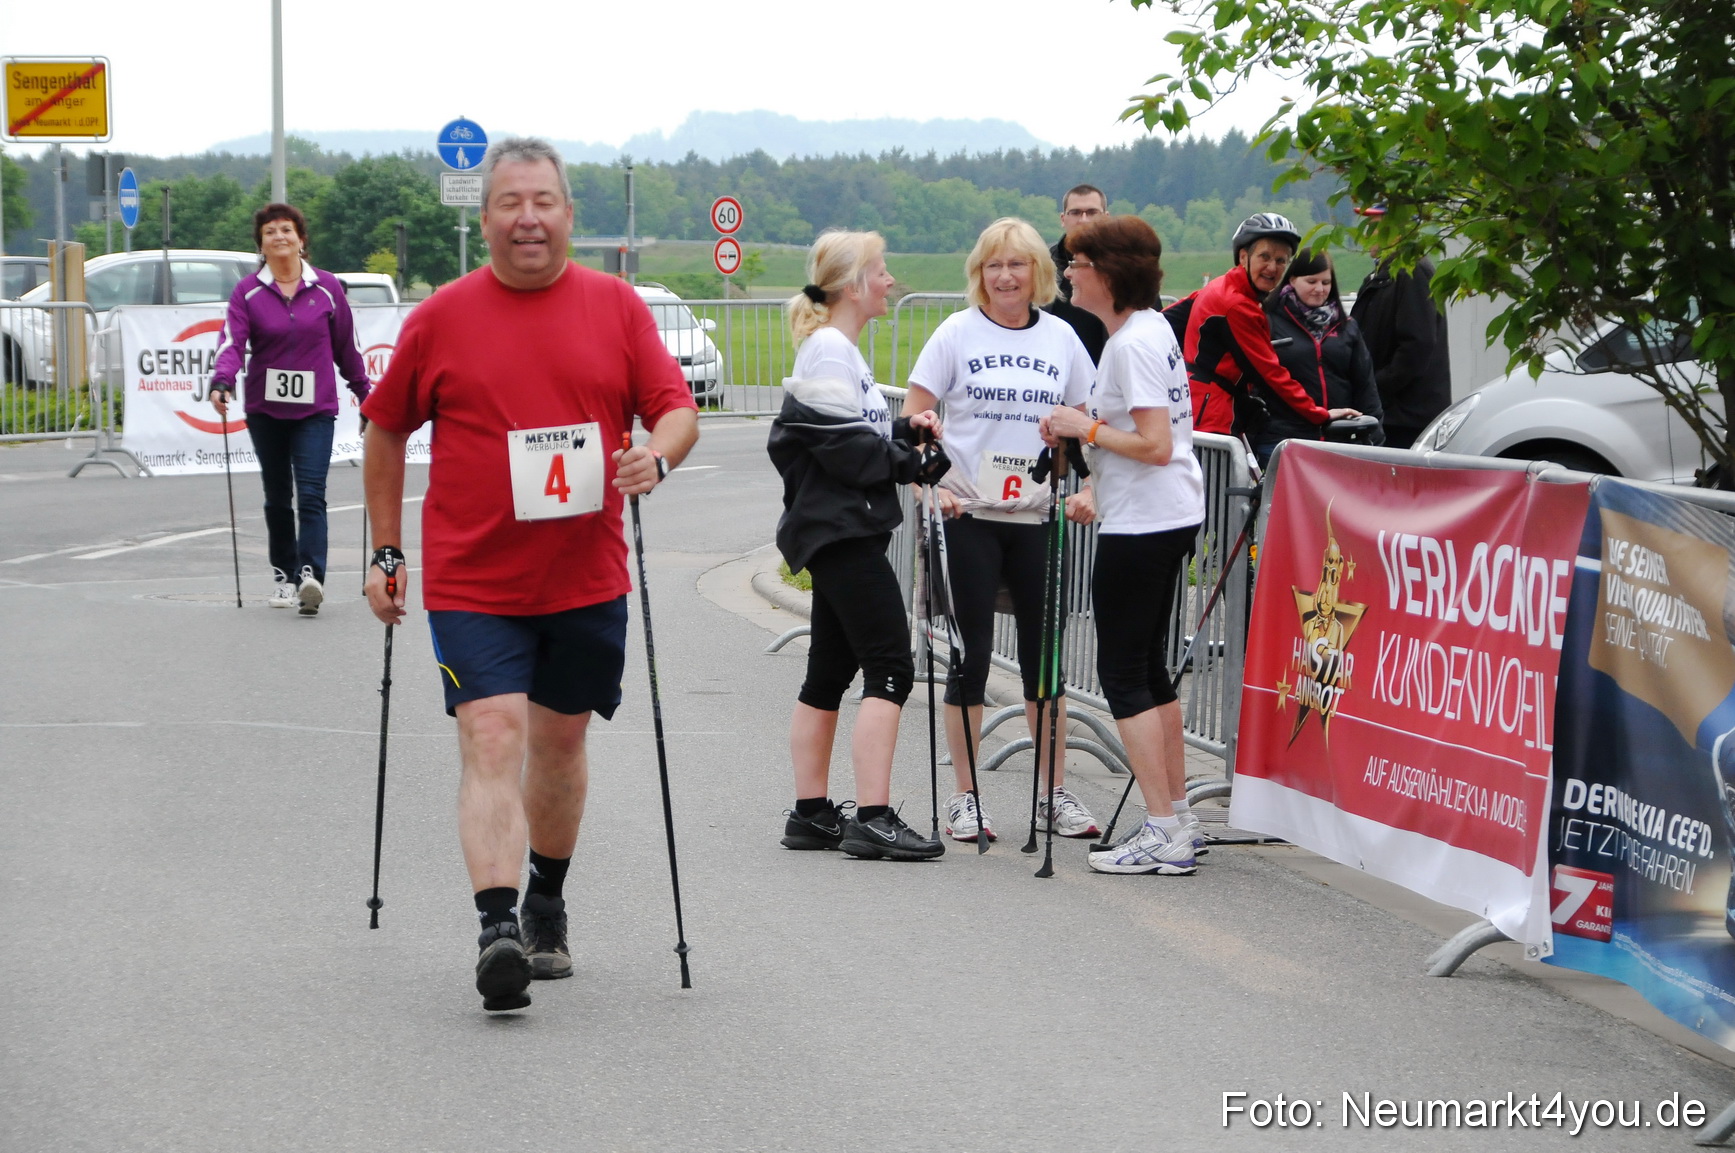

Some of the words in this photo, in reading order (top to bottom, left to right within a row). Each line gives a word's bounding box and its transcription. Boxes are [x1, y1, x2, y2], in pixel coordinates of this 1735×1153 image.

[12, 70, 97, 94] Sengenthal
[34, 116, 71, 127] Neumarkt
[718, 207, 736, 224] 60
[968, 354, 1060, 381] BERGER
[138, 378, 193, 391] Autohaus
[276, 373, 304, 398] 30
[966, 385, 1017, 402] POWER
[1004, 412, 1021, 421] and
[525, 430, 569, 444] MEYER
[525, 441, 570, 452] WERBUNG
[992, 463, 1026, 473] WERBUNG
[993, 455, 1026, 466] MEYER
[544, 453, 571, 503] 4
[1002, 474, 1022, 506] 6
[1363, 755, 1389, 788] AUF
[1563, 778, 1618, 818] DER
[1556, 816, 1622, 858] JETZT
[1552, 872, 1598, 925] 7
